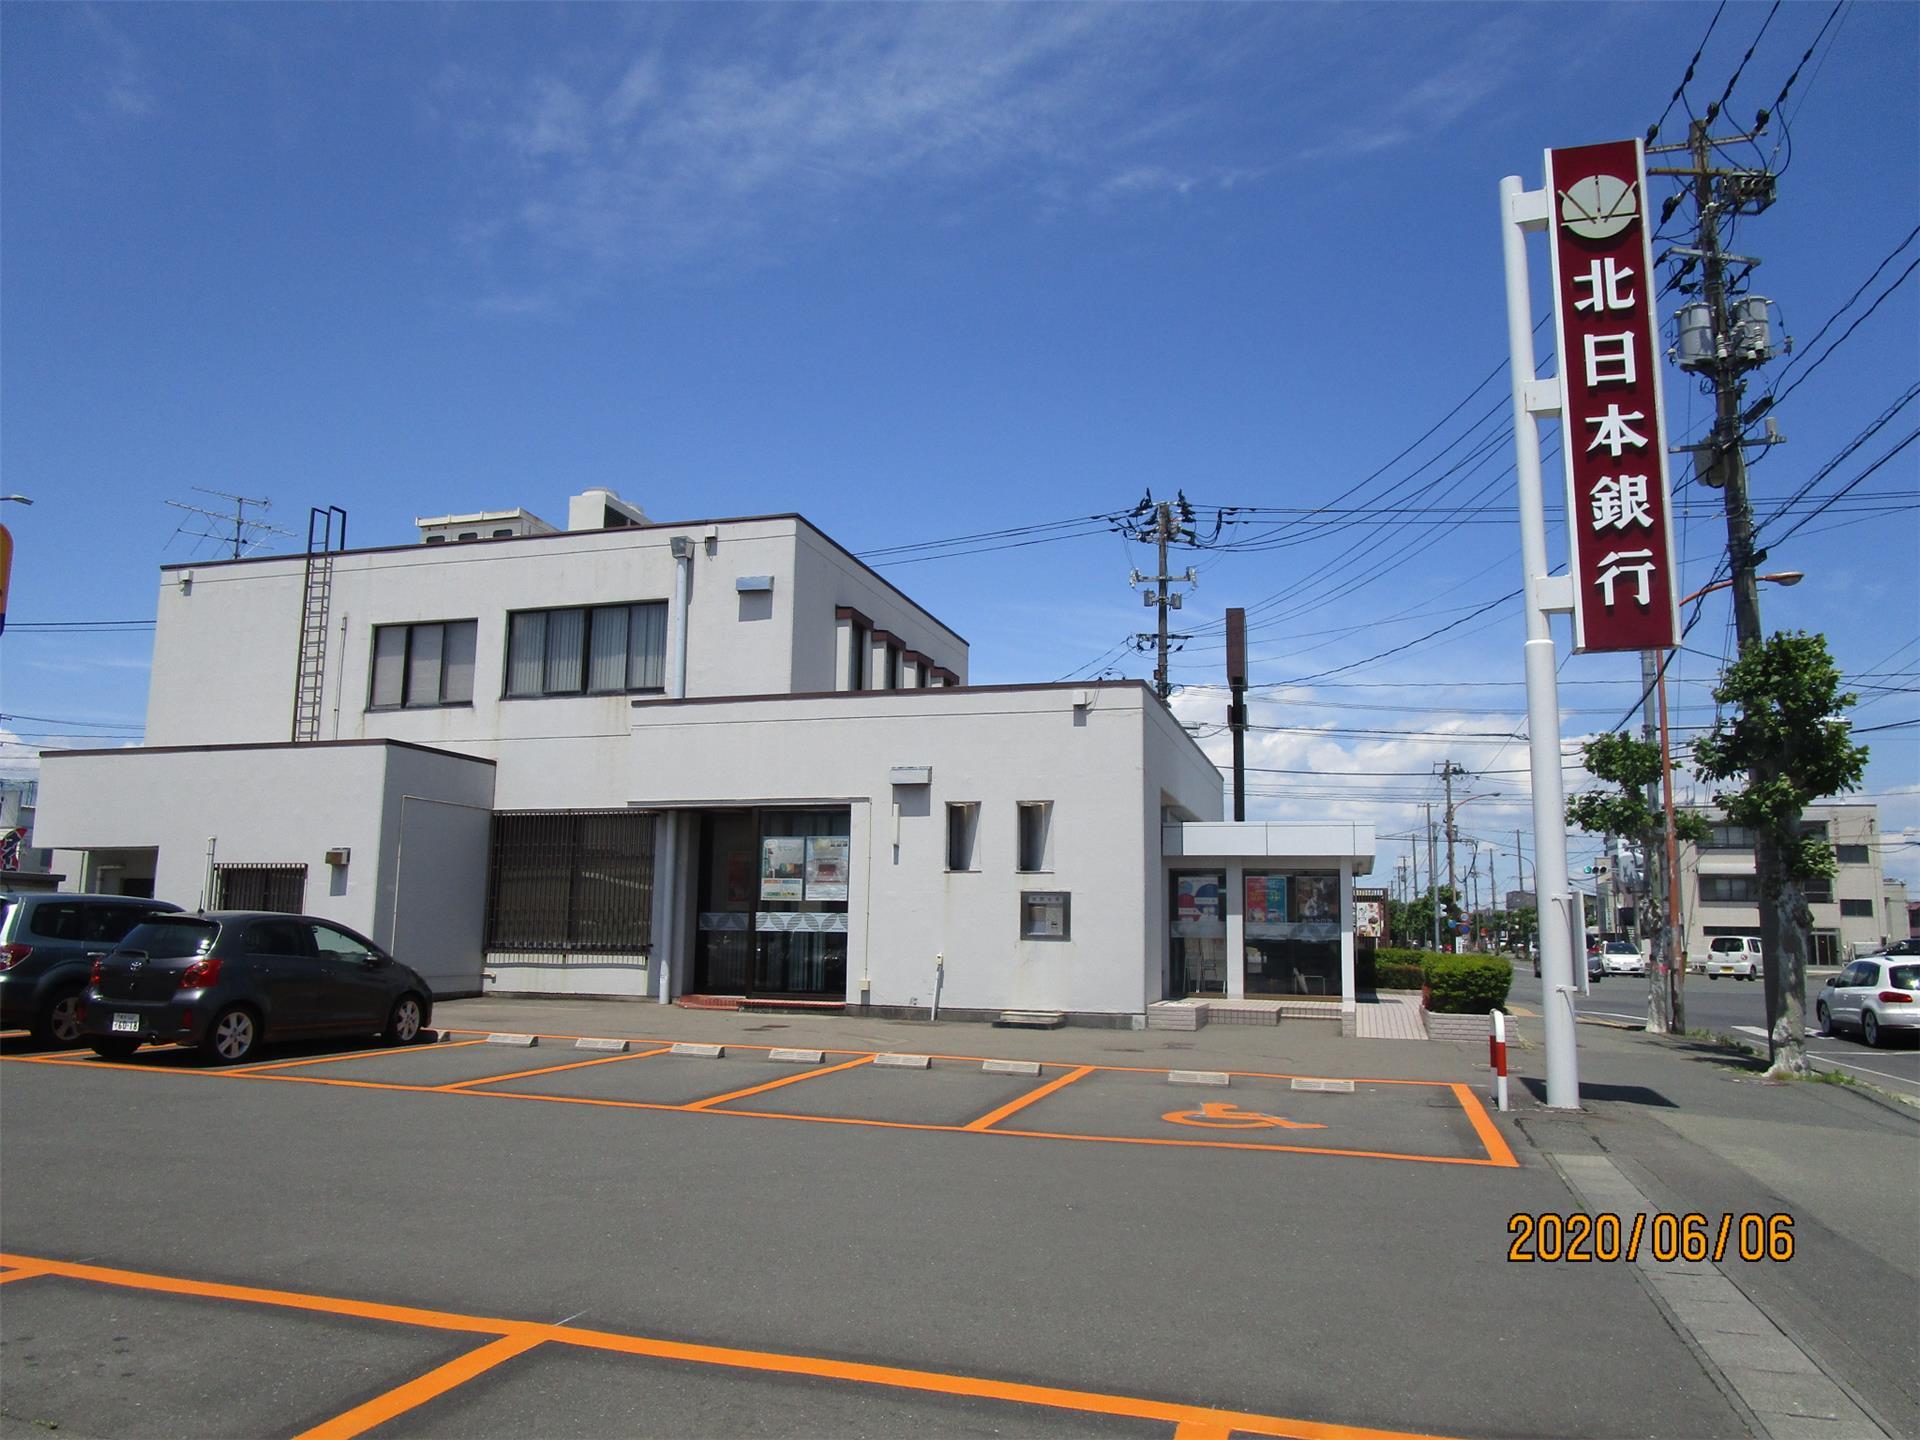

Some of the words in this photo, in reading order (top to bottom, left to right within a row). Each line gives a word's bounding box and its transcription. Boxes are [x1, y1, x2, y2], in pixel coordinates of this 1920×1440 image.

[1573, 257, 1656, 606] 北日本銀行
